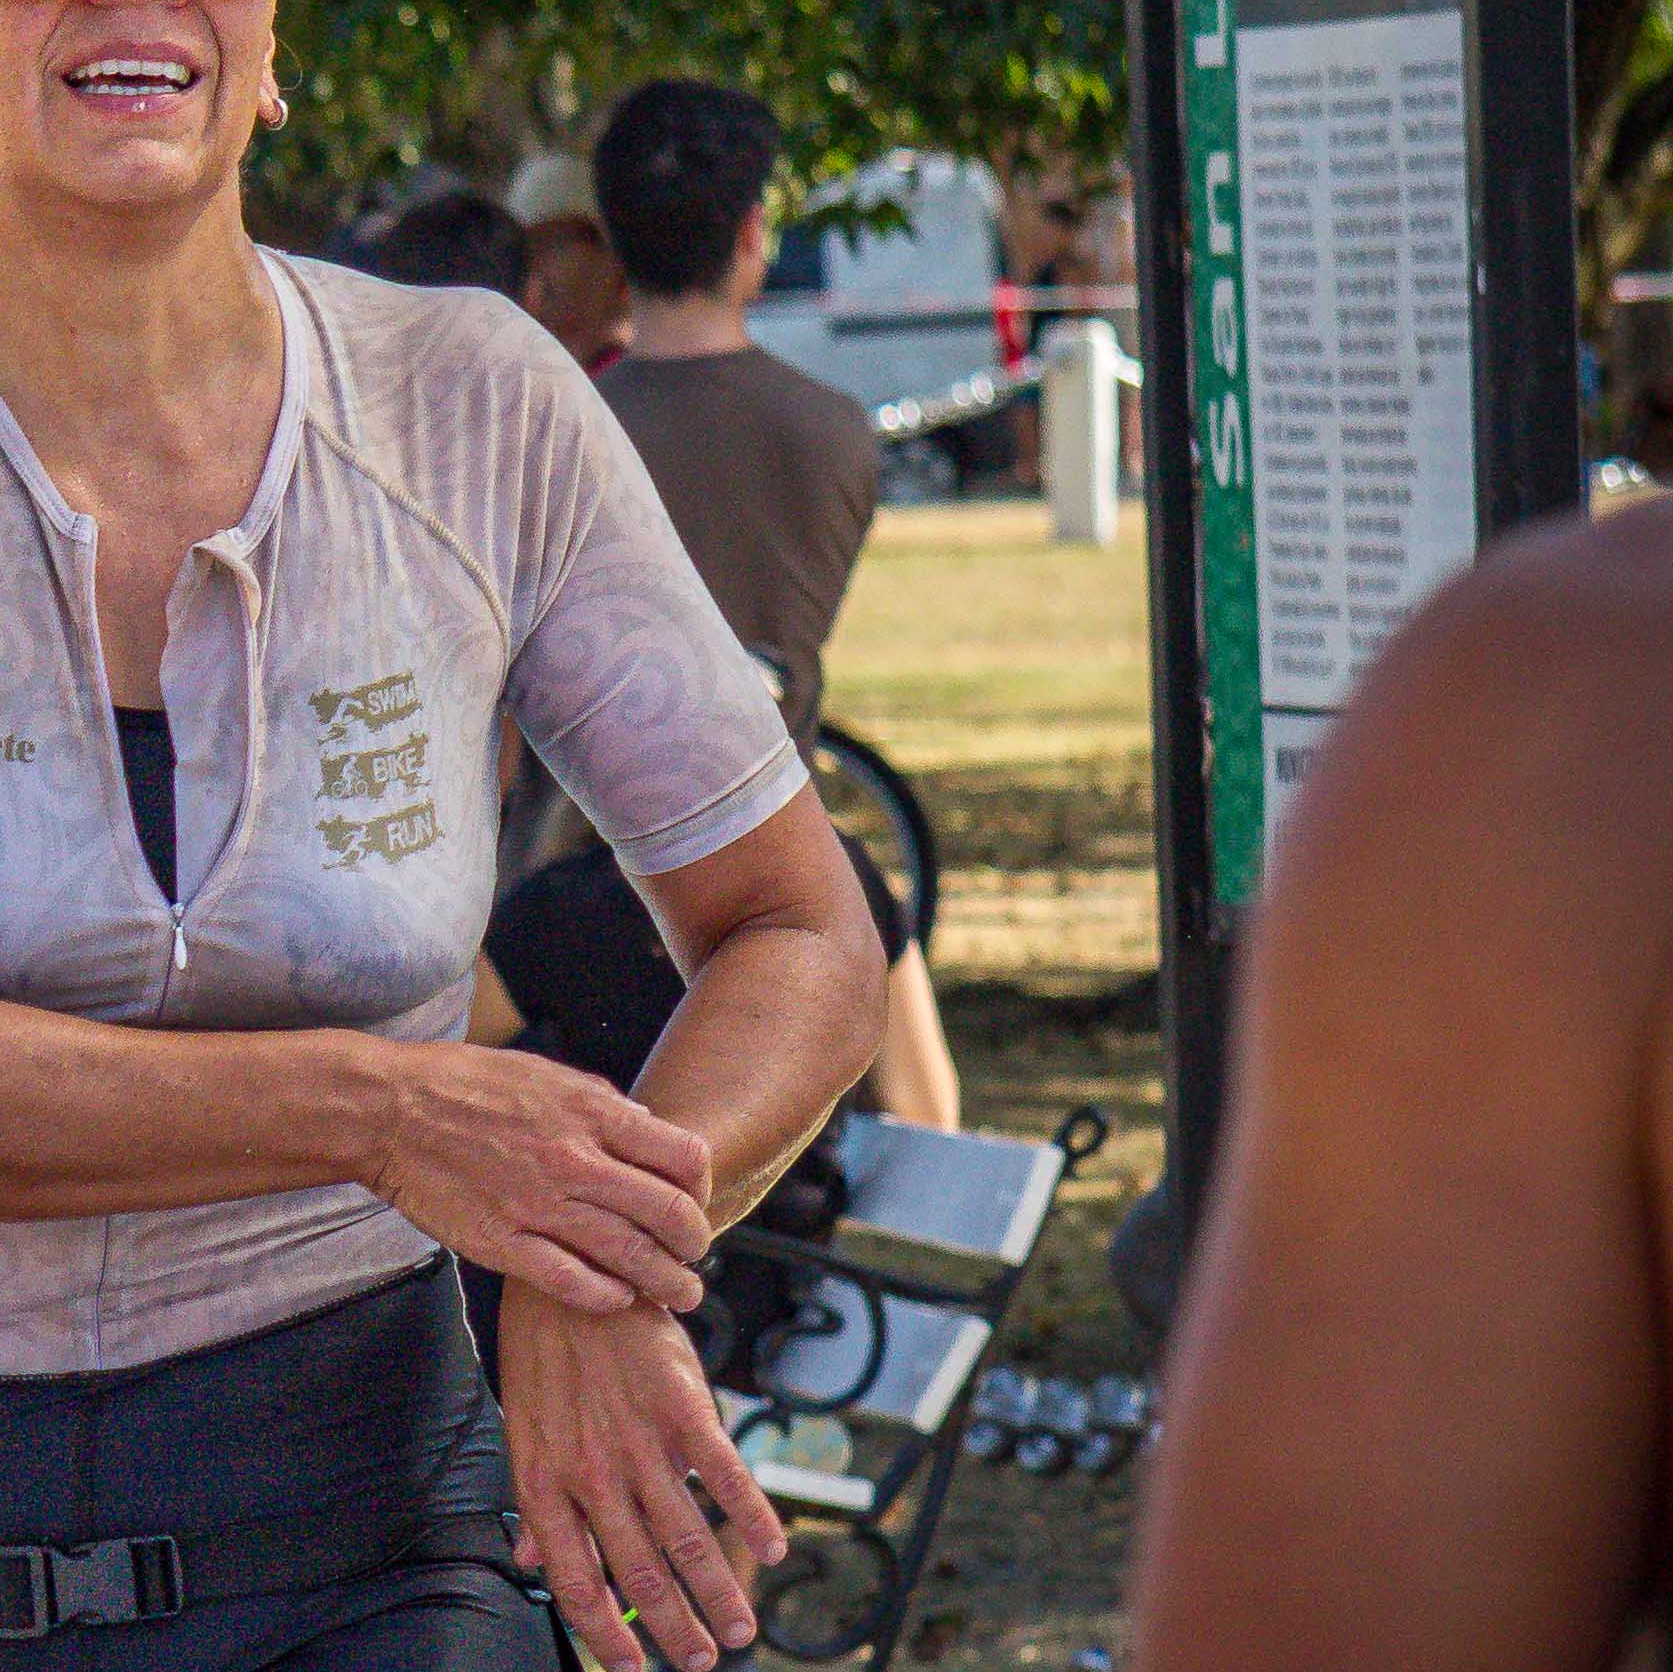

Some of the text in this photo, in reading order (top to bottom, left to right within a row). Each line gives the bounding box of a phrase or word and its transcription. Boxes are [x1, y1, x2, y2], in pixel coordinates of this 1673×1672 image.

[367, 677, 417, 716] SWIM
[372, 745, 424, 784] BIKE
[386, 808, 435, 852] RUN
